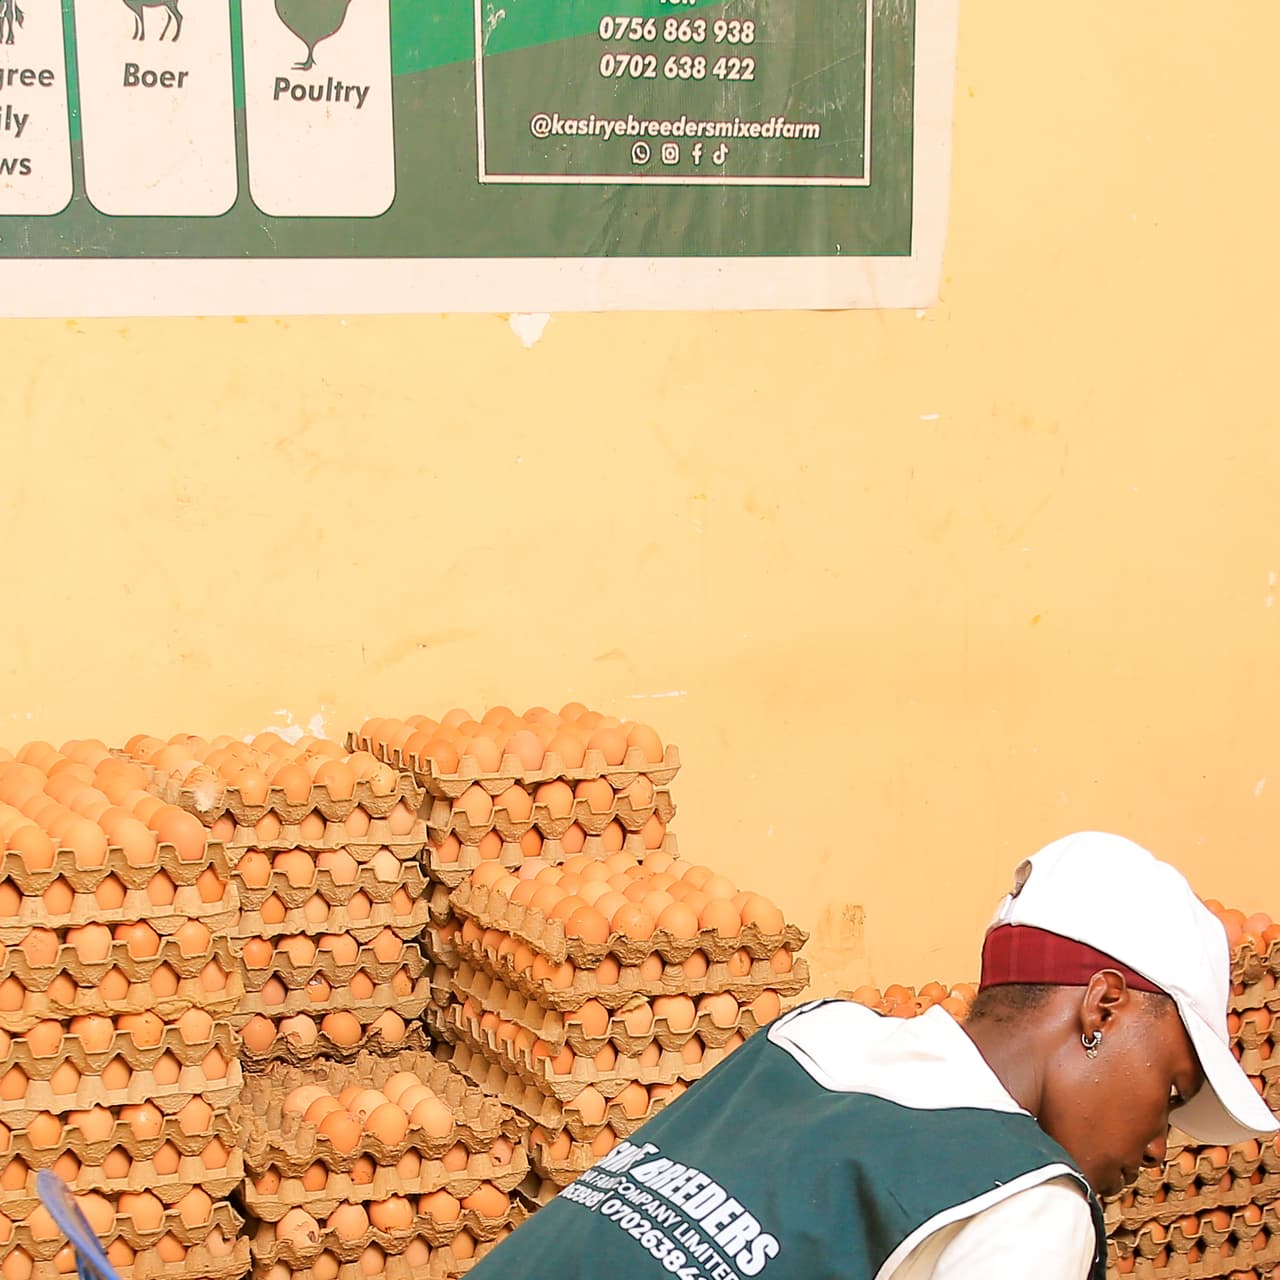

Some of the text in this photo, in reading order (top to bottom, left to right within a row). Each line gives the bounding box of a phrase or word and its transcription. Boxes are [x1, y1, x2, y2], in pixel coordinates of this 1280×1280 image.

[599, 16, 755, 44] 0756 863 938
[122, 62, 189, 90] Boer
[599, 54, 755, 80] 0702 638 422
[273, 76, 371, 110] Poultry
[531, 113, 821, 140] @kasiryebreedersmixedfarm
[618, 1176, 682, 1227] COMPANY
[629, 1158, 780, 1277] BREEDERS
